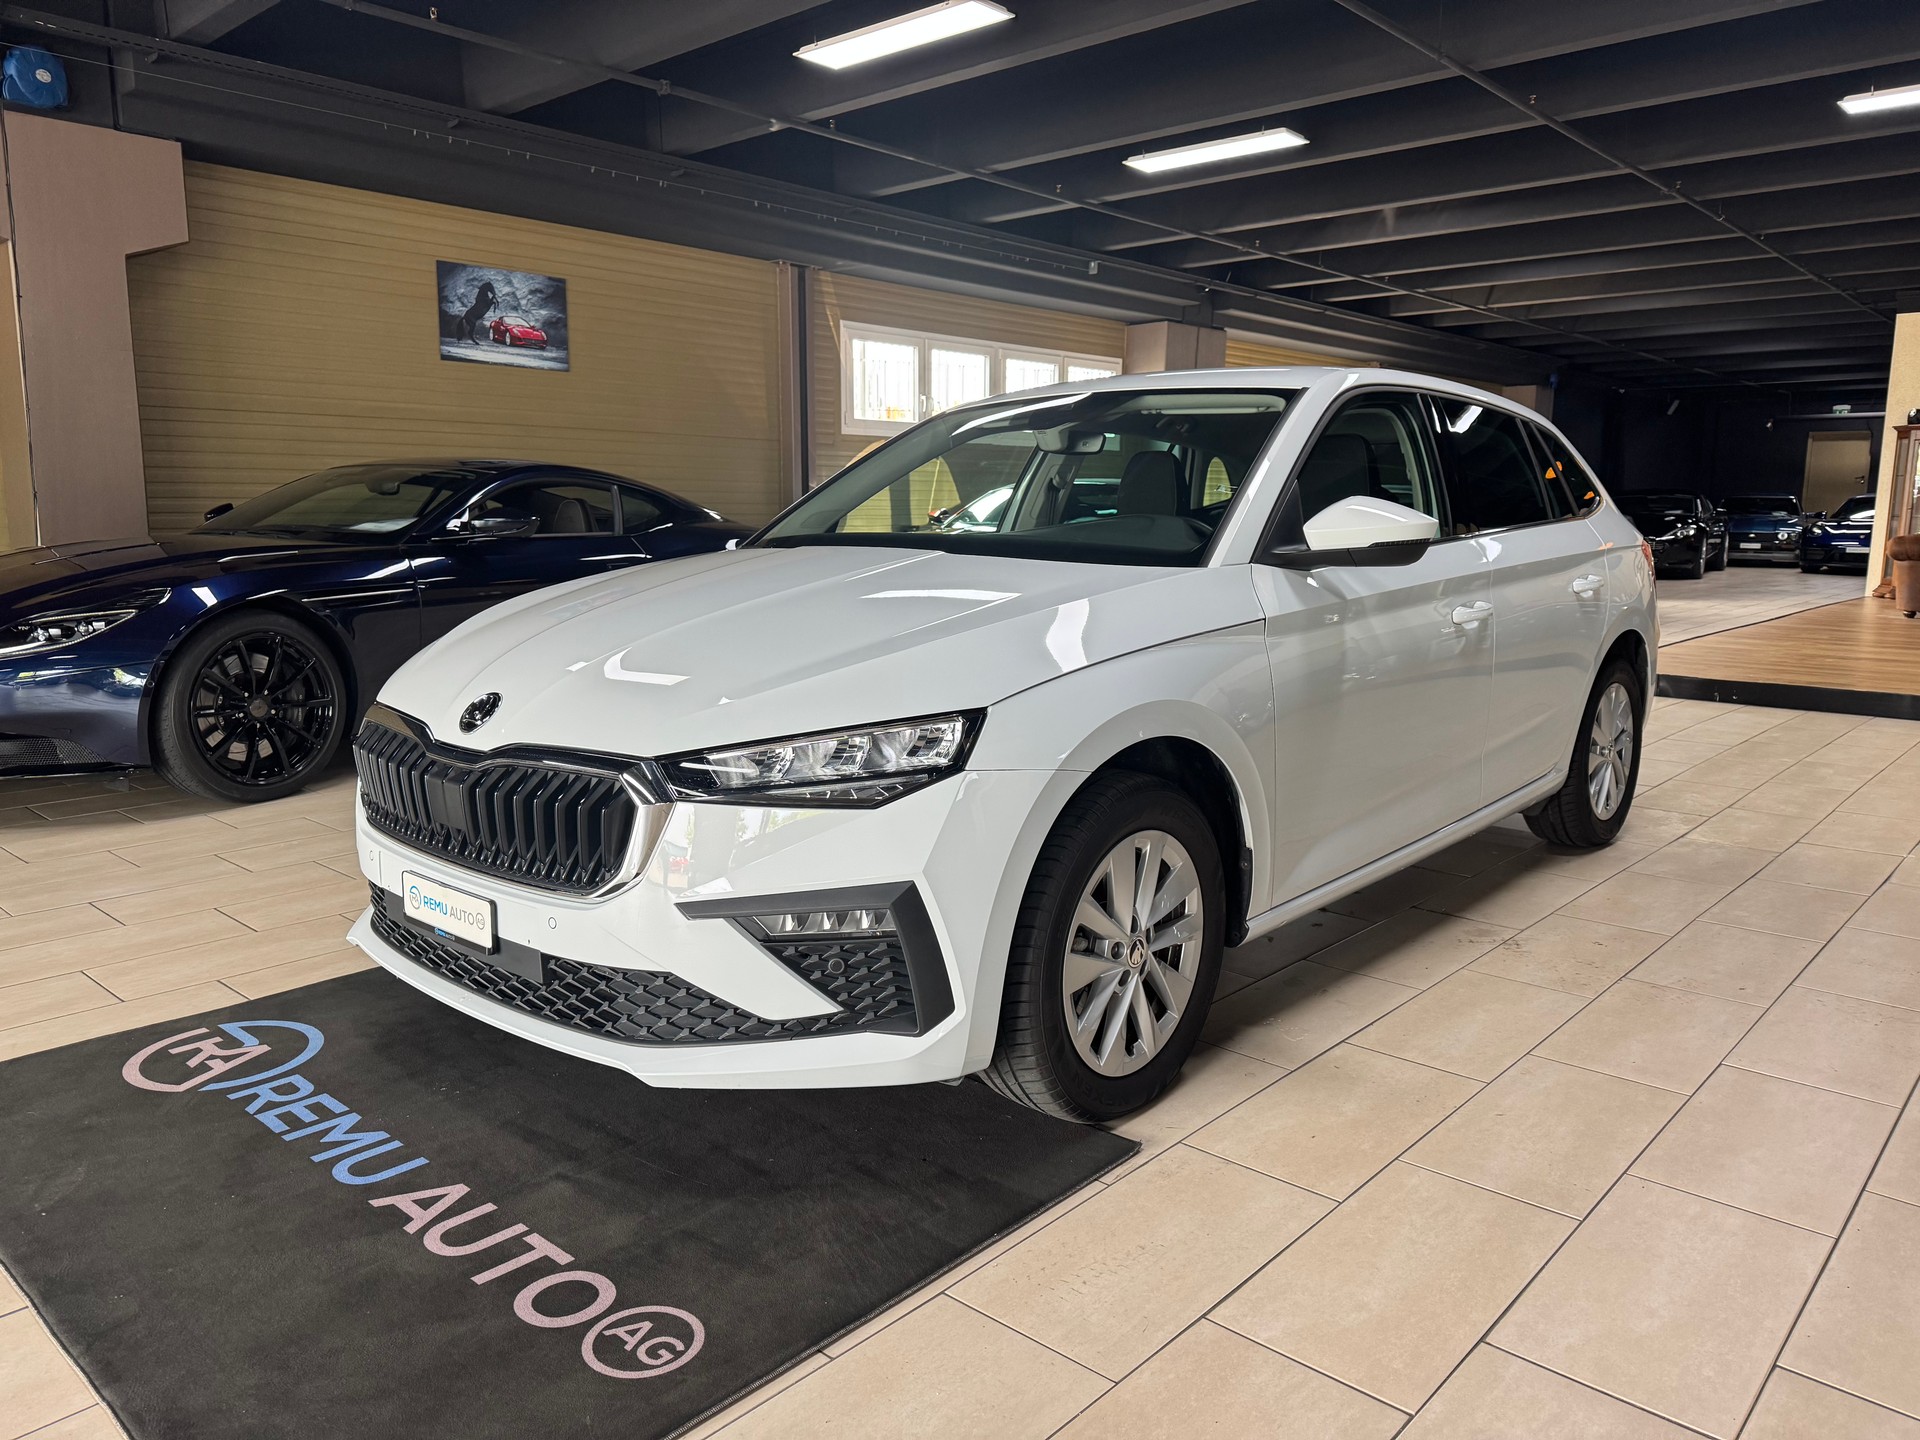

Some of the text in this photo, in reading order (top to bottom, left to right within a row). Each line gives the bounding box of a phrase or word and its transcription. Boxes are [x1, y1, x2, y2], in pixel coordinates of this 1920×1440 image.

[423, 895, 448, 916] REMU
[449, 906, 475, 926] AUTO
[226, 1074, 429, 1185] REMU
[368, 1183, 616, 1328] AUTO
[603, 1320, 685, 1366] AG
